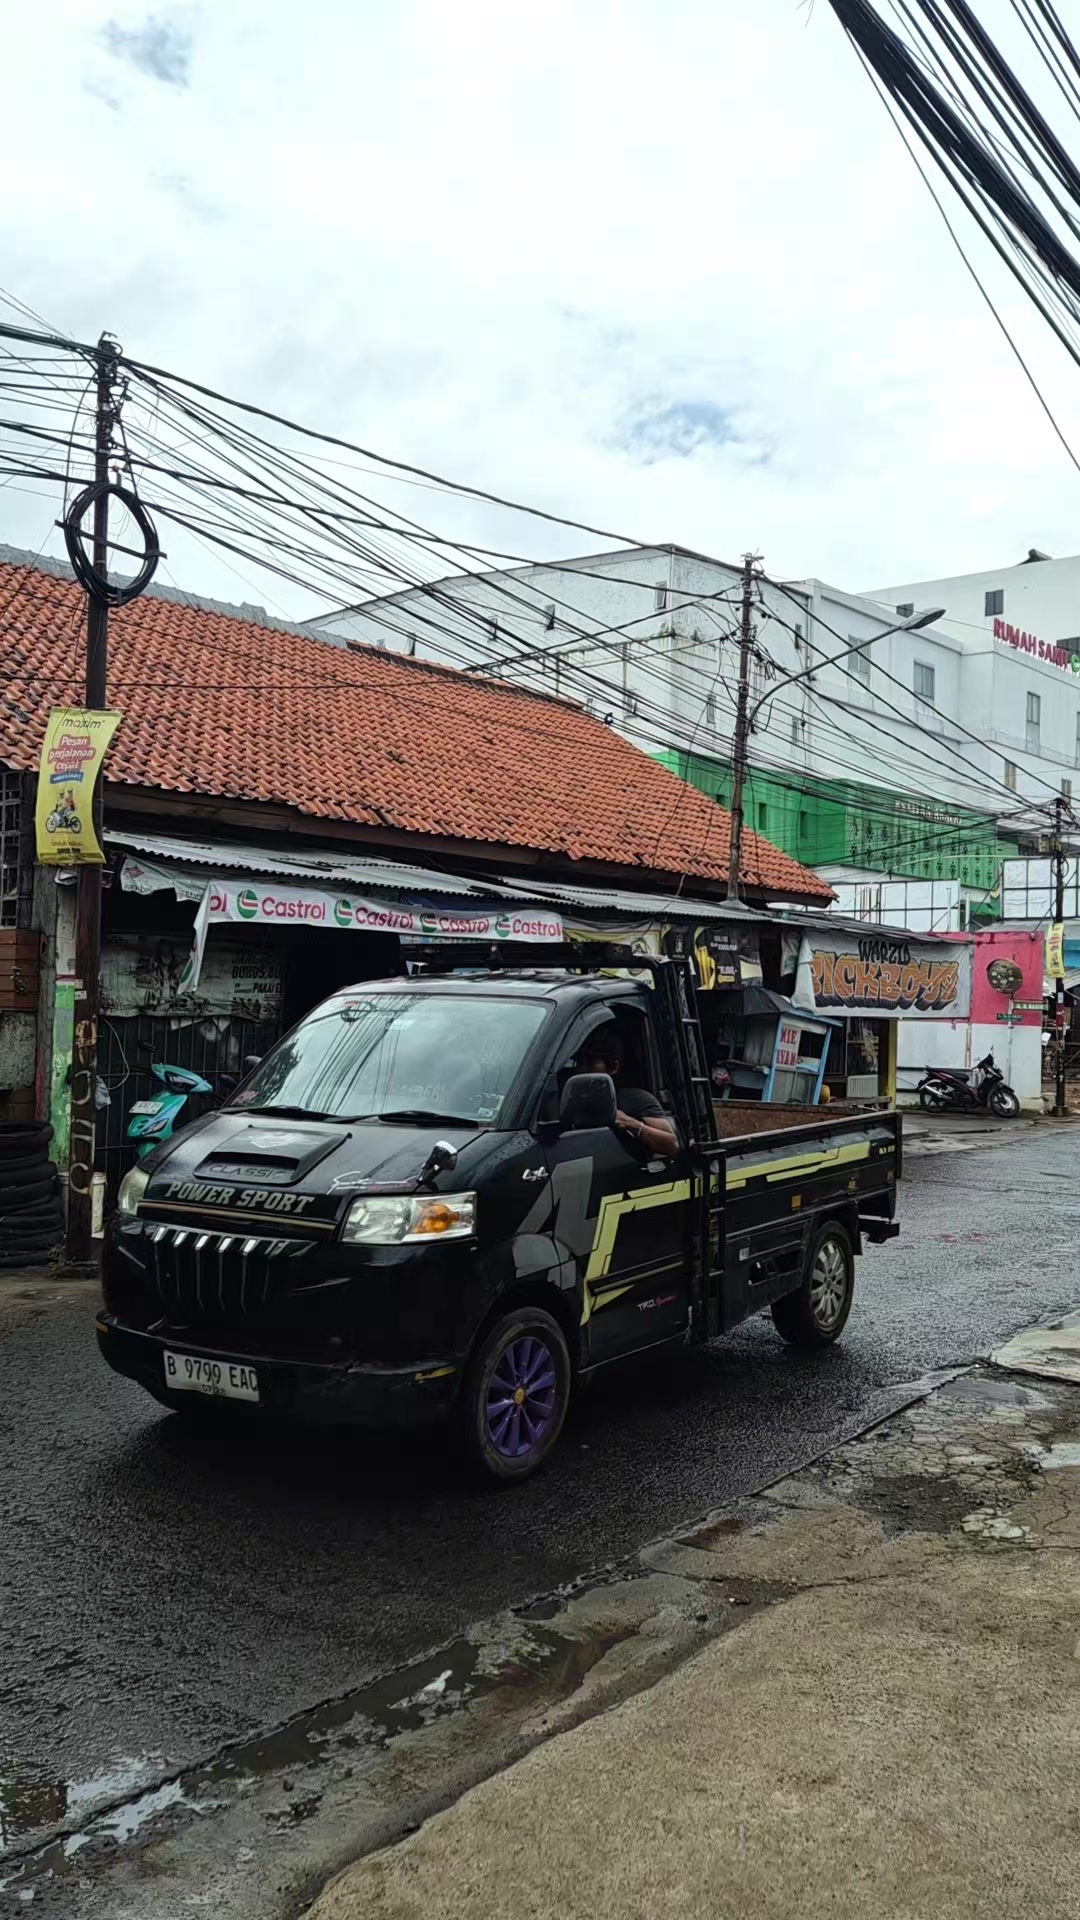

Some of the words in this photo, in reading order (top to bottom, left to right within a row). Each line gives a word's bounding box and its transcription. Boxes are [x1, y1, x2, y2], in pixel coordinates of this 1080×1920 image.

[994, 617, 1037, 656] RUMAH
[62, 718, 101, 729] maxim
[61, 736, 88, 746] Pesan
[49, 747, 94, 760] perjalanan
[261, 896, 326, 921] Castrol
[355, 906, 414, 930] Castrol
[438, 916, 490, 934] Castrol
[512, 918, 562, 937] Castrol
[780, 1027, 797, 1045] MIE
[776, 1048, 797, 1066] AYAM
[208, 1163, 286, 1180] CLASSIC
[164, 1181, 236, 1205] POWER
[236, 1189, 315, 1214] SPORT
[167, 1355, 177, 1376] B
[184, 1358, 222, 1385] 9799
